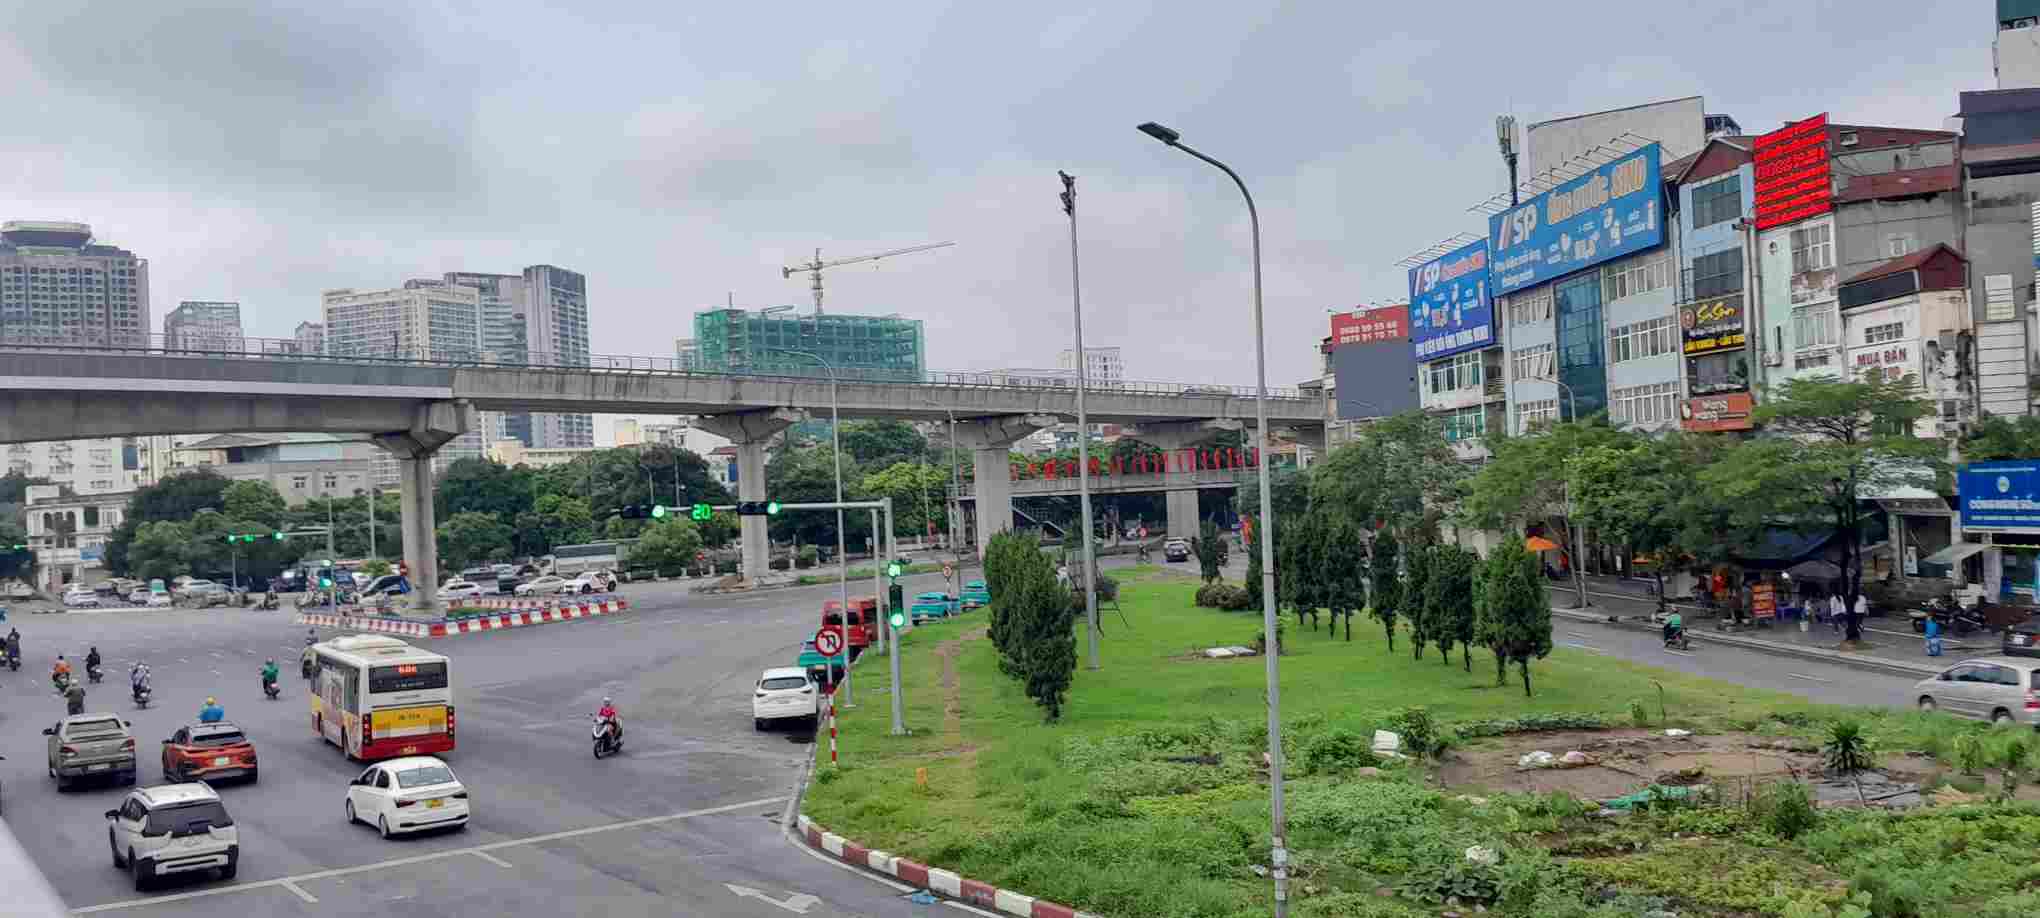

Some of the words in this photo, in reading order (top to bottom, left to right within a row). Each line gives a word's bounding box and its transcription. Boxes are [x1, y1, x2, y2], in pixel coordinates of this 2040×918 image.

[1857, 352, 1881, 367] MUA
[1884, 346, 1906, 362] BÁN
[692, 503, 713, 520] 20
